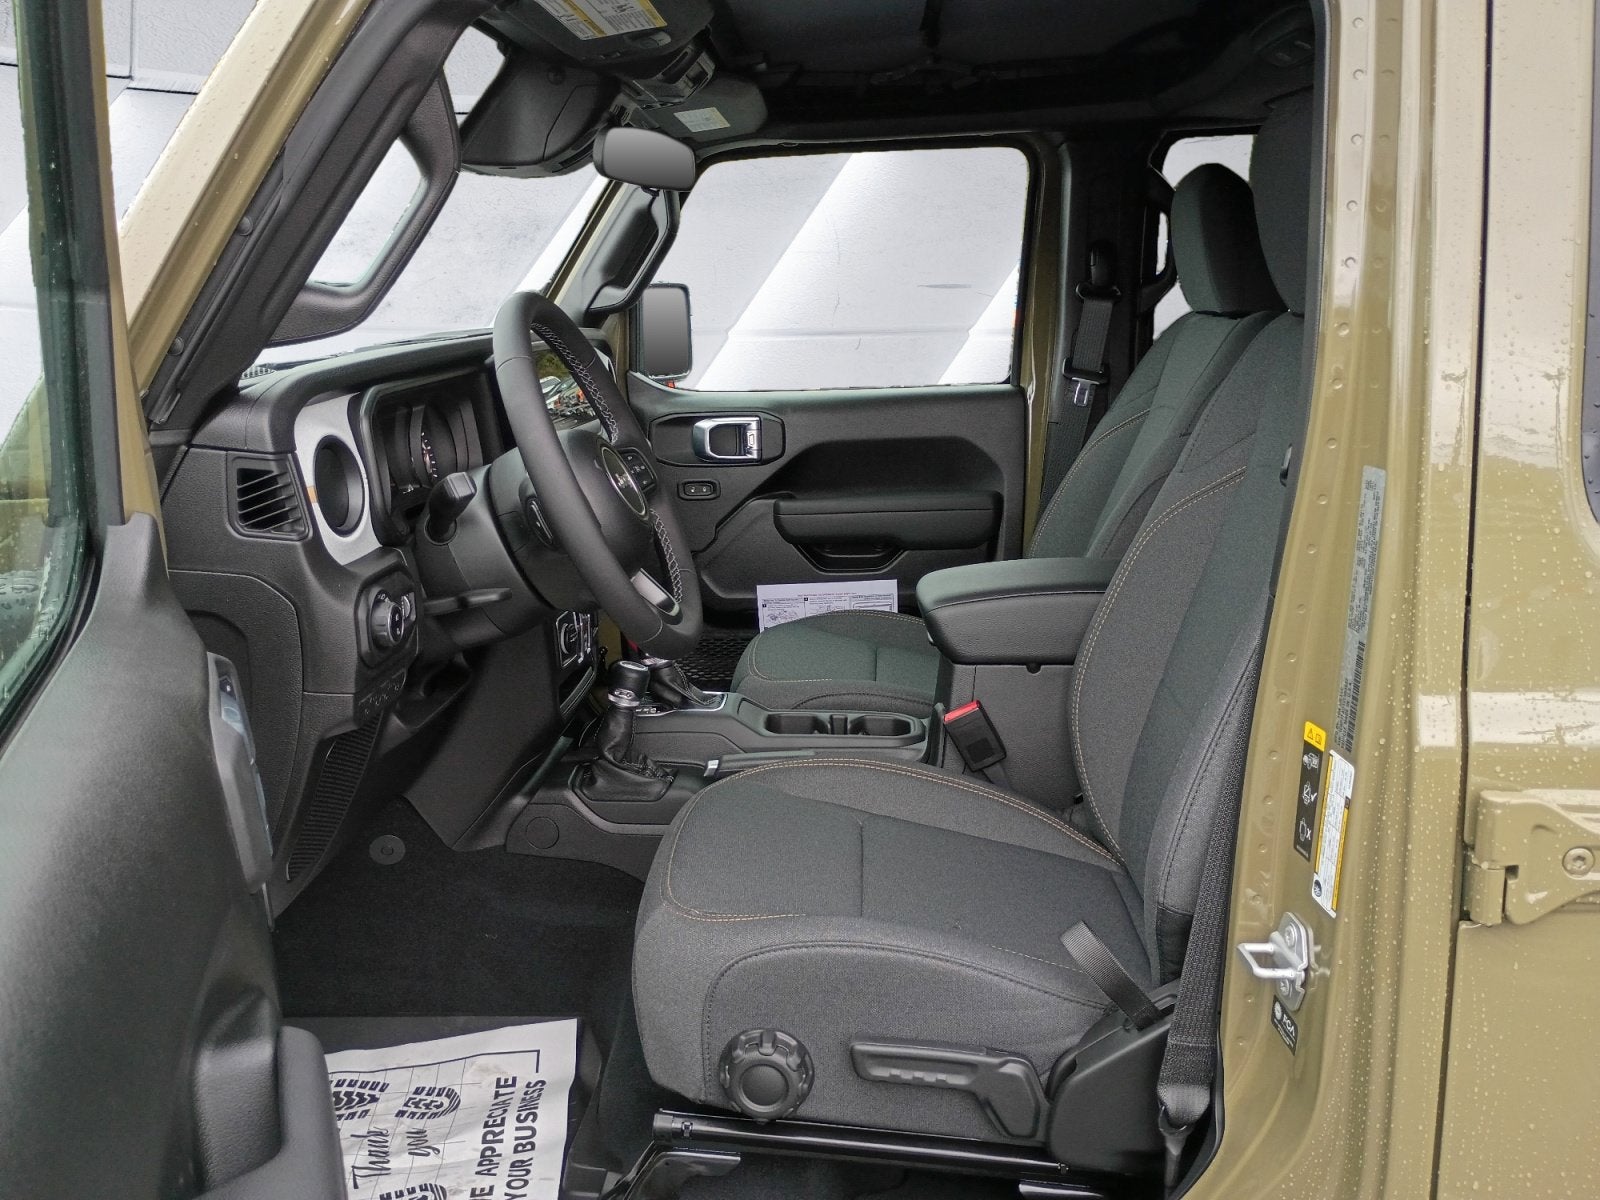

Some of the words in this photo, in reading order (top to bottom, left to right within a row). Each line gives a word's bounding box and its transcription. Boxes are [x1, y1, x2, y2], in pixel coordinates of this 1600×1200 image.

[407, 1128, 441, 1157] you
[475, 1076, 517, 1177] APPRECIATE
[513, 1079, 547, 1154] BUSINESS
[350, 1126, 391, 1189] Thank
[504, 1157, 534, 1200] YOUR
[468, 1185, 495, 1200] E
